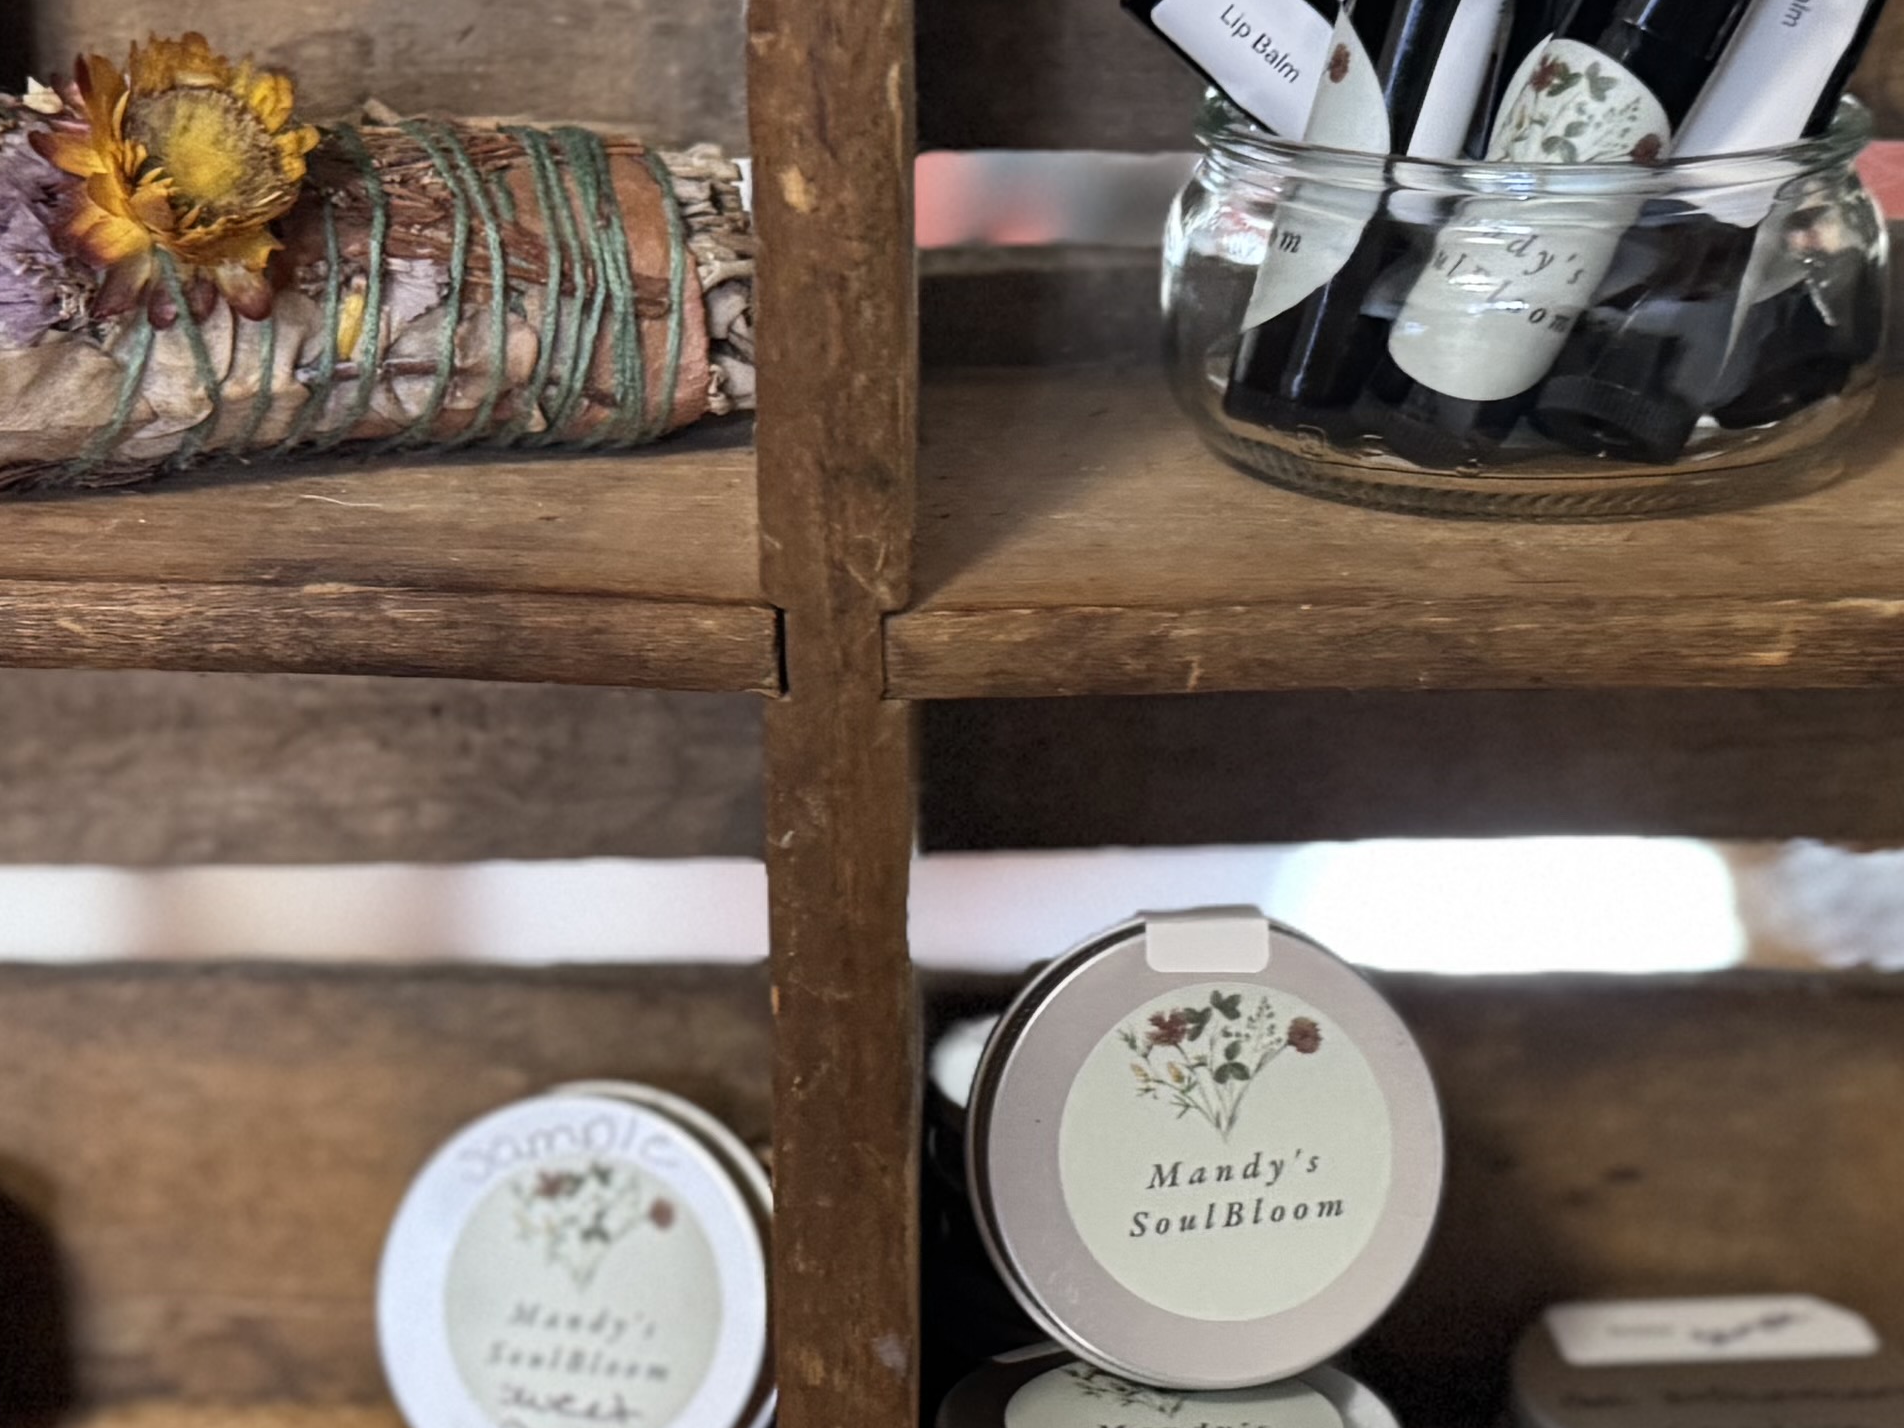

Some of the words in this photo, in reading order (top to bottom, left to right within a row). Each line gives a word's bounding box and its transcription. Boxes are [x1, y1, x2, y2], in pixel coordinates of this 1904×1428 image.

[1219, 3, 1252, 38] Lip
[1251, 32, 1300, 84] Balm
[1146, 1148, 1320, 1189] Mandy's
[1128, 1197, 1344, 1238] SoulBloom
